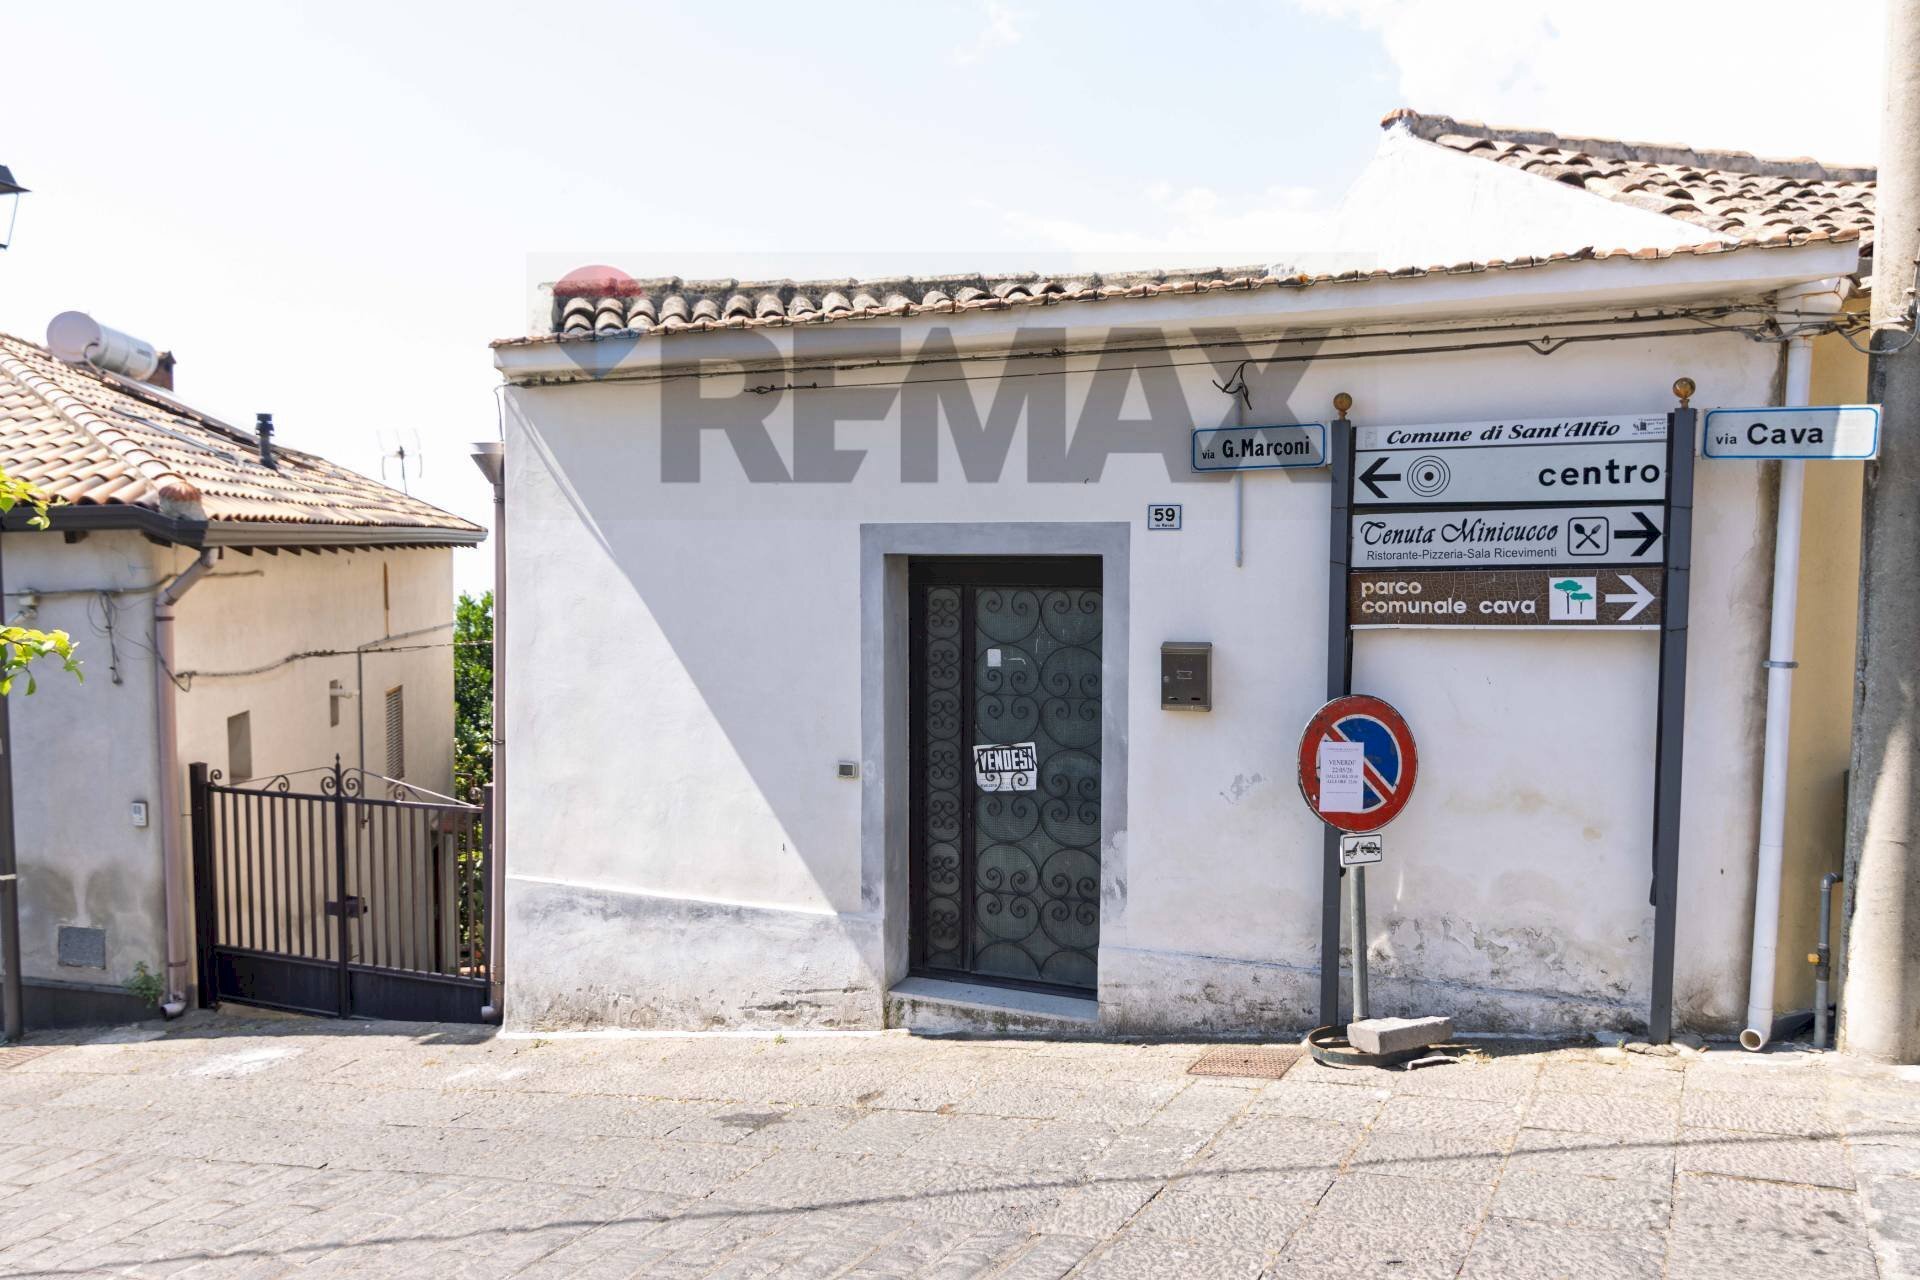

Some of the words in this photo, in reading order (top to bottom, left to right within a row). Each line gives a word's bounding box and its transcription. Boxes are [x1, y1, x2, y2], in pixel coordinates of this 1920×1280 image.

[1387, 429, 1472, 445] Comune
[1479, 425, 1502, 442] di
[1508, 421, 1620, 440] Sant'Alfio
[1715, 433, 1737, 445] via
[1746, 422, 1824, 446] Cava
[1202, 449, 1215, 460] via
[1222, 435, 1310, 458] G.Marconi
[1538, 458, 1660, 487] centro
[1154, 507, 1175, 522] 59
[1360, 520, 1436, 546] Tenuta
[1441, 518, 1559, 544] Minicucco
[1494, 546, 1557, 559] Ricevimenti
[1360, 581, 1422, 598] parco
[1361, 597, 1467, 615] comunale
[1478, 600, 1536, 614] cava
[978, 748, 1034, 772] VENDESI
